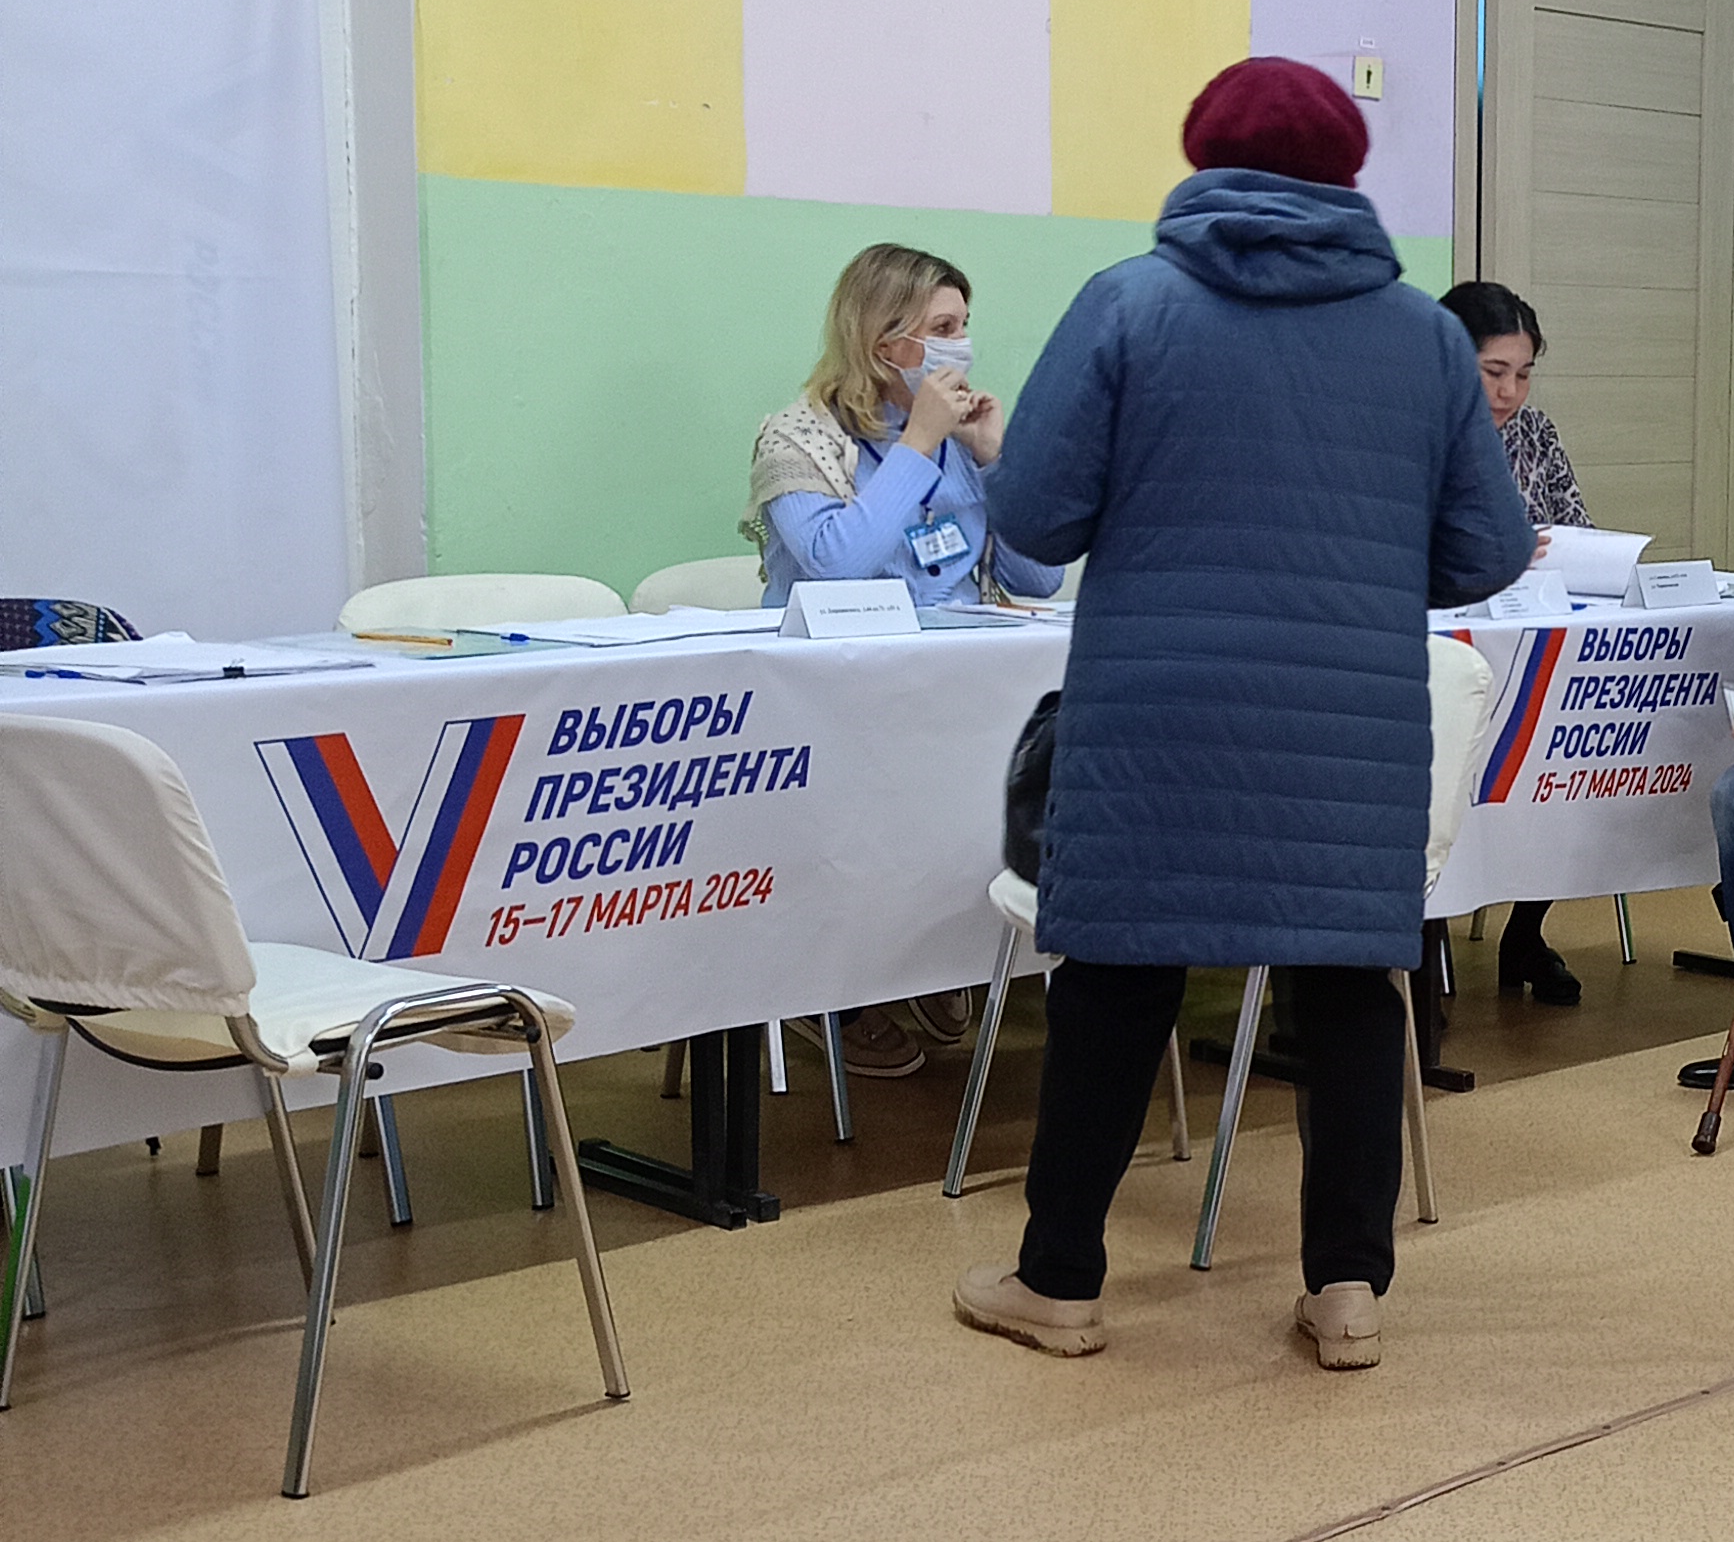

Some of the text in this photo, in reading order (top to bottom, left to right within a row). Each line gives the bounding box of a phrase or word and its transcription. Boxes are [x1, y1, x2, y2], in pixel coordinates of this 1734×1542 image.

[1577, 626, 1693, 662] ВЫБОРЫ
[1560, 672, 1719, 713] ПРЕЗИДЕНТА
[547, 690, 754, 756] ВЫБОРЫ
[1545, 721, 1652, 760] РОССИИ
[523, 745, 811, 823] ПРЕЗИДЕНТА
[1585, 766, 1649, 800] МАРТА
[1648, 763, 1693, 795] 2024
[501, 819, 694, 889] РОССИИ
[584, 878, 694, 933] МАРТА
[697, 866, 774, 914] 2024
